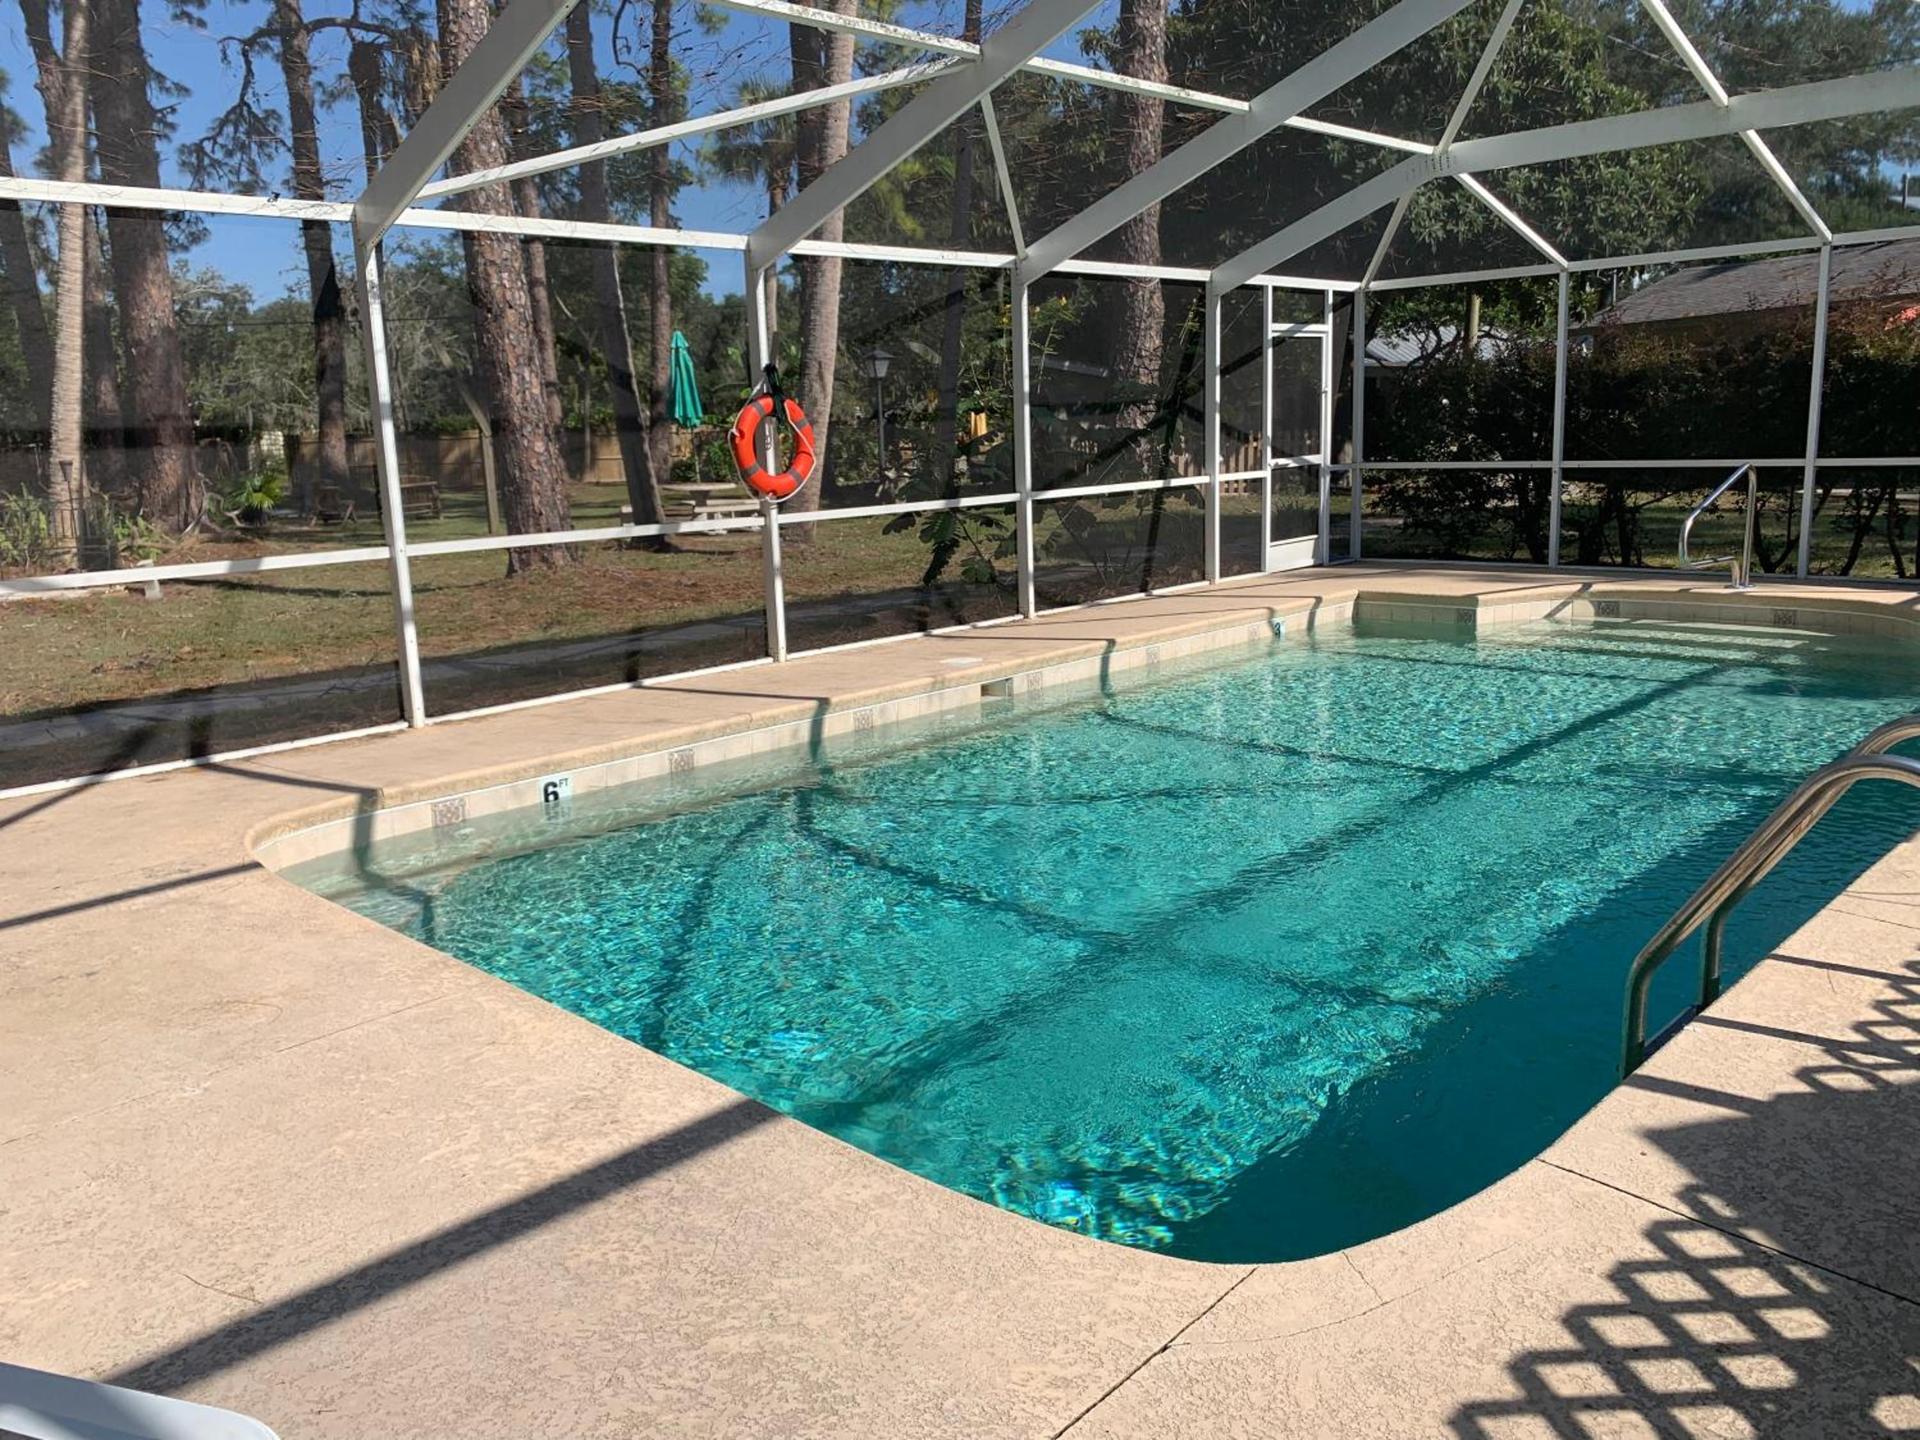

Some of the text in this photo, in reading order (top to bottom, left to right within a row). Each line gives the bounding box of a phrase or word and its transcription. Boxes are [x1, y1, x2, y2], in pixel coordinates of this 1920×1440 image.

[1274, 621, 1281, 637] 3
[543, 777, 569, 803] 6 FT
